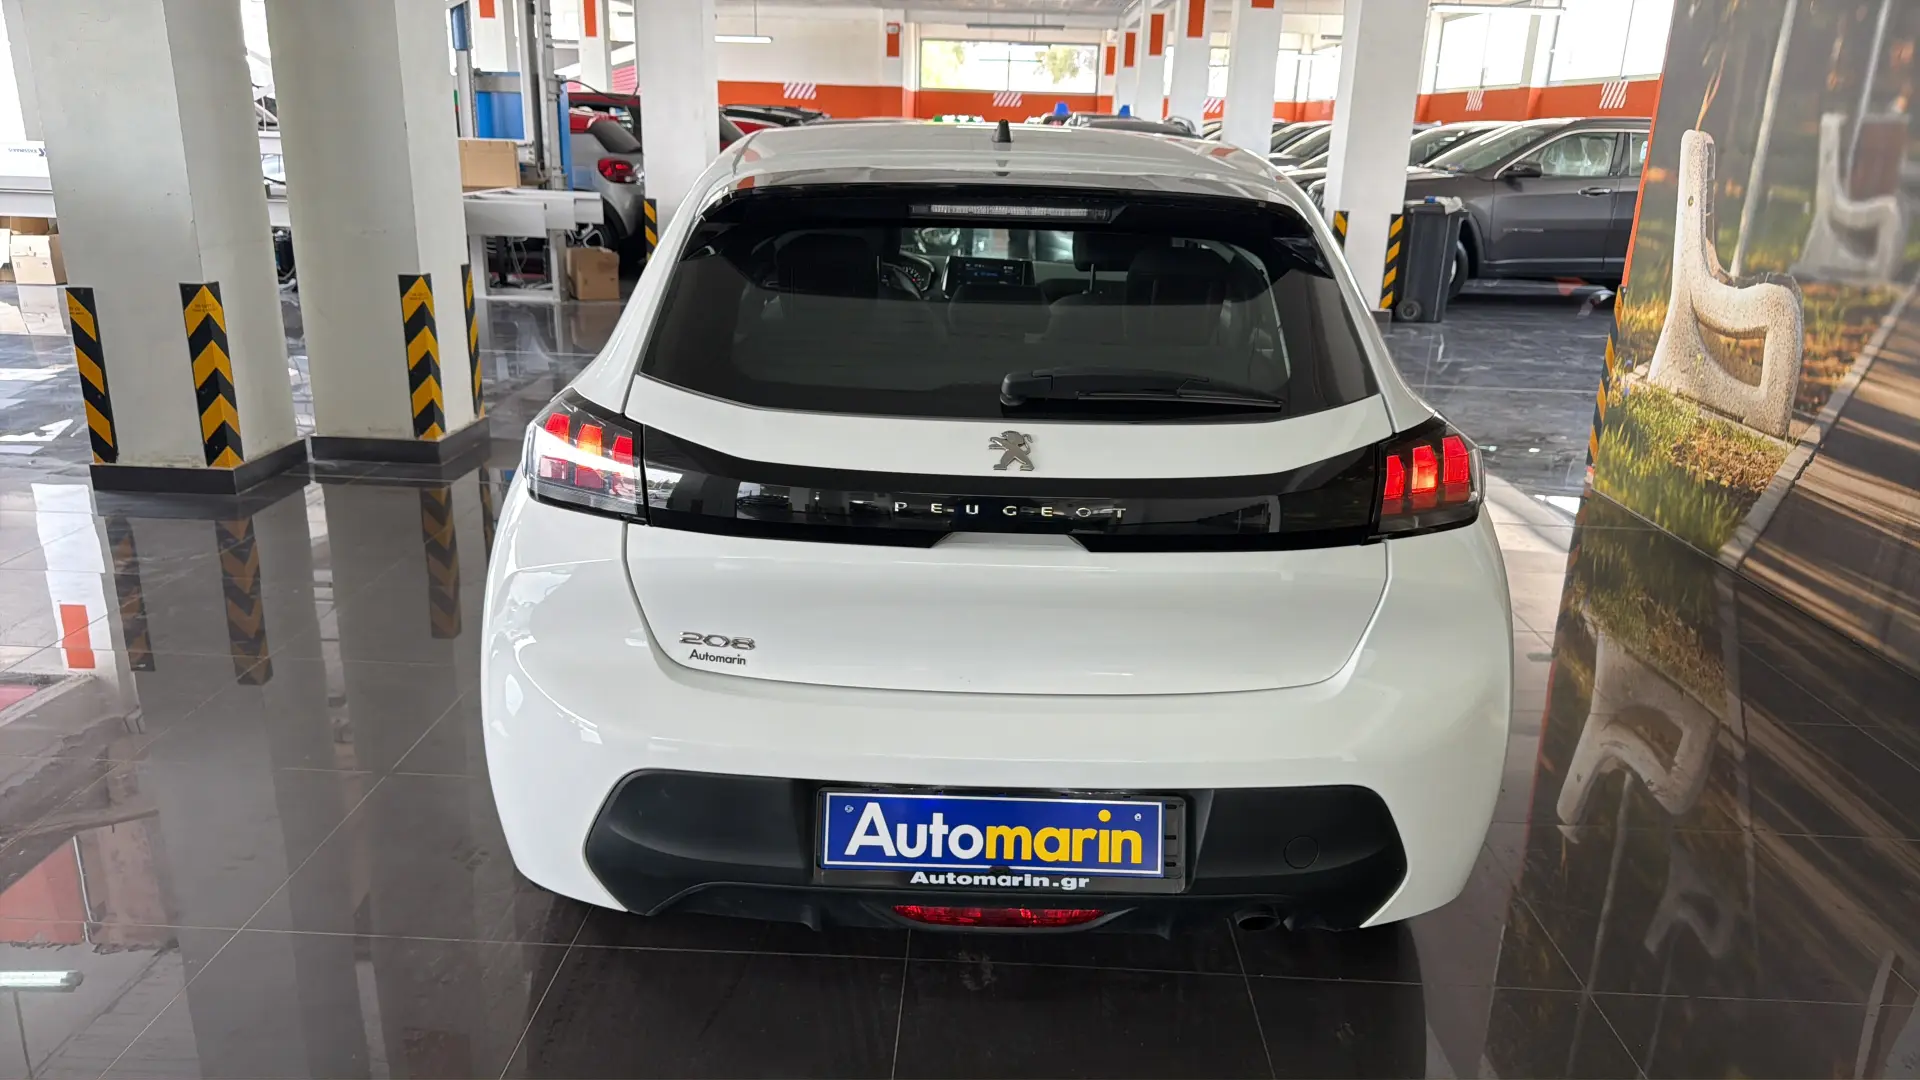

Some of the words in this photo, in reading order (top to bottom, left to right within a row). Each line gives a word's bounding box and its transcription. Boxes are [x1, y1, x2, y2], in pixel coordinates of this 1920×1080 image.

[894, 501, 1127, 518] PEUGEOT
[679, 631, 756, 650] 208
[689, 648, 746, 665] Automarin
[844, 802, 1142, 864] Automarin
[910, 871, 1090, 890] Automarin.gr
